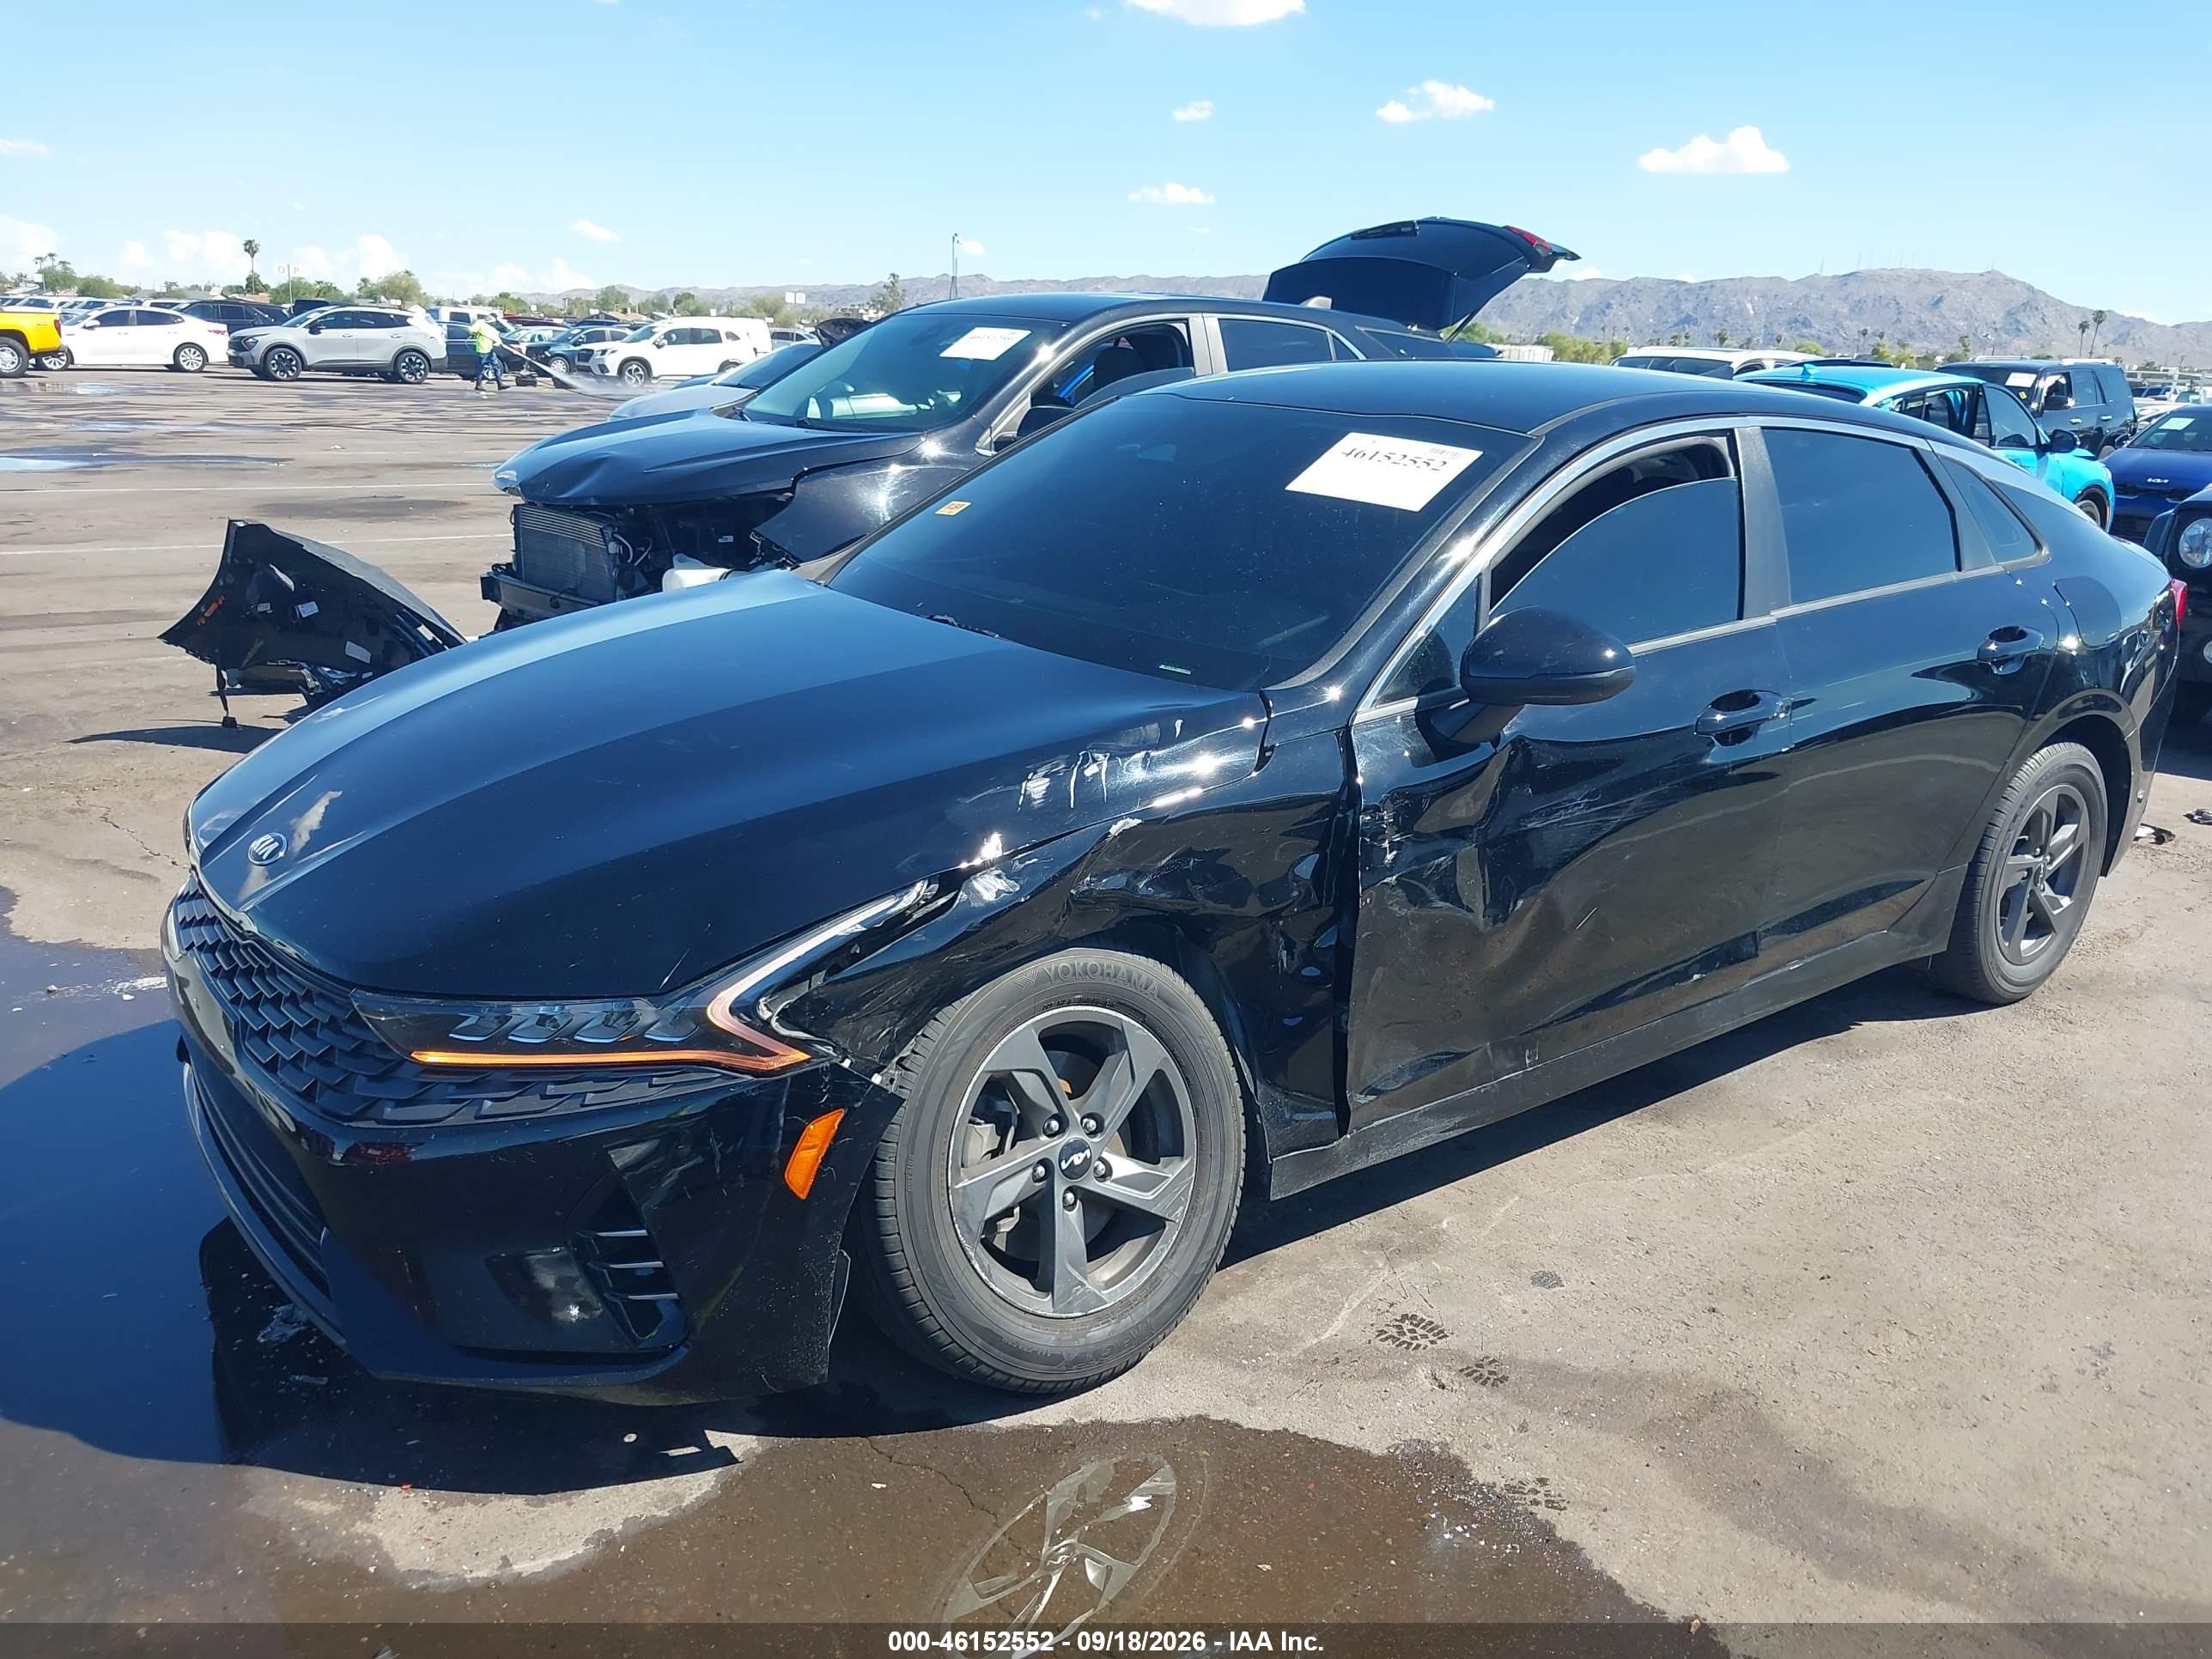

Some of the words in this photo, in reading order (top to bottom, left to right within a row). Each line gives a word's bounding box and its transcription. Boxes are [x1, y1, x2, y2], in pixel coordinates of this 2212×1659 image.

[1341, 447, 1448, 471] 46152552
[252, 834, 280, 860] KIA
[1043, 961, 1160, 1000] YOKOHAMA
